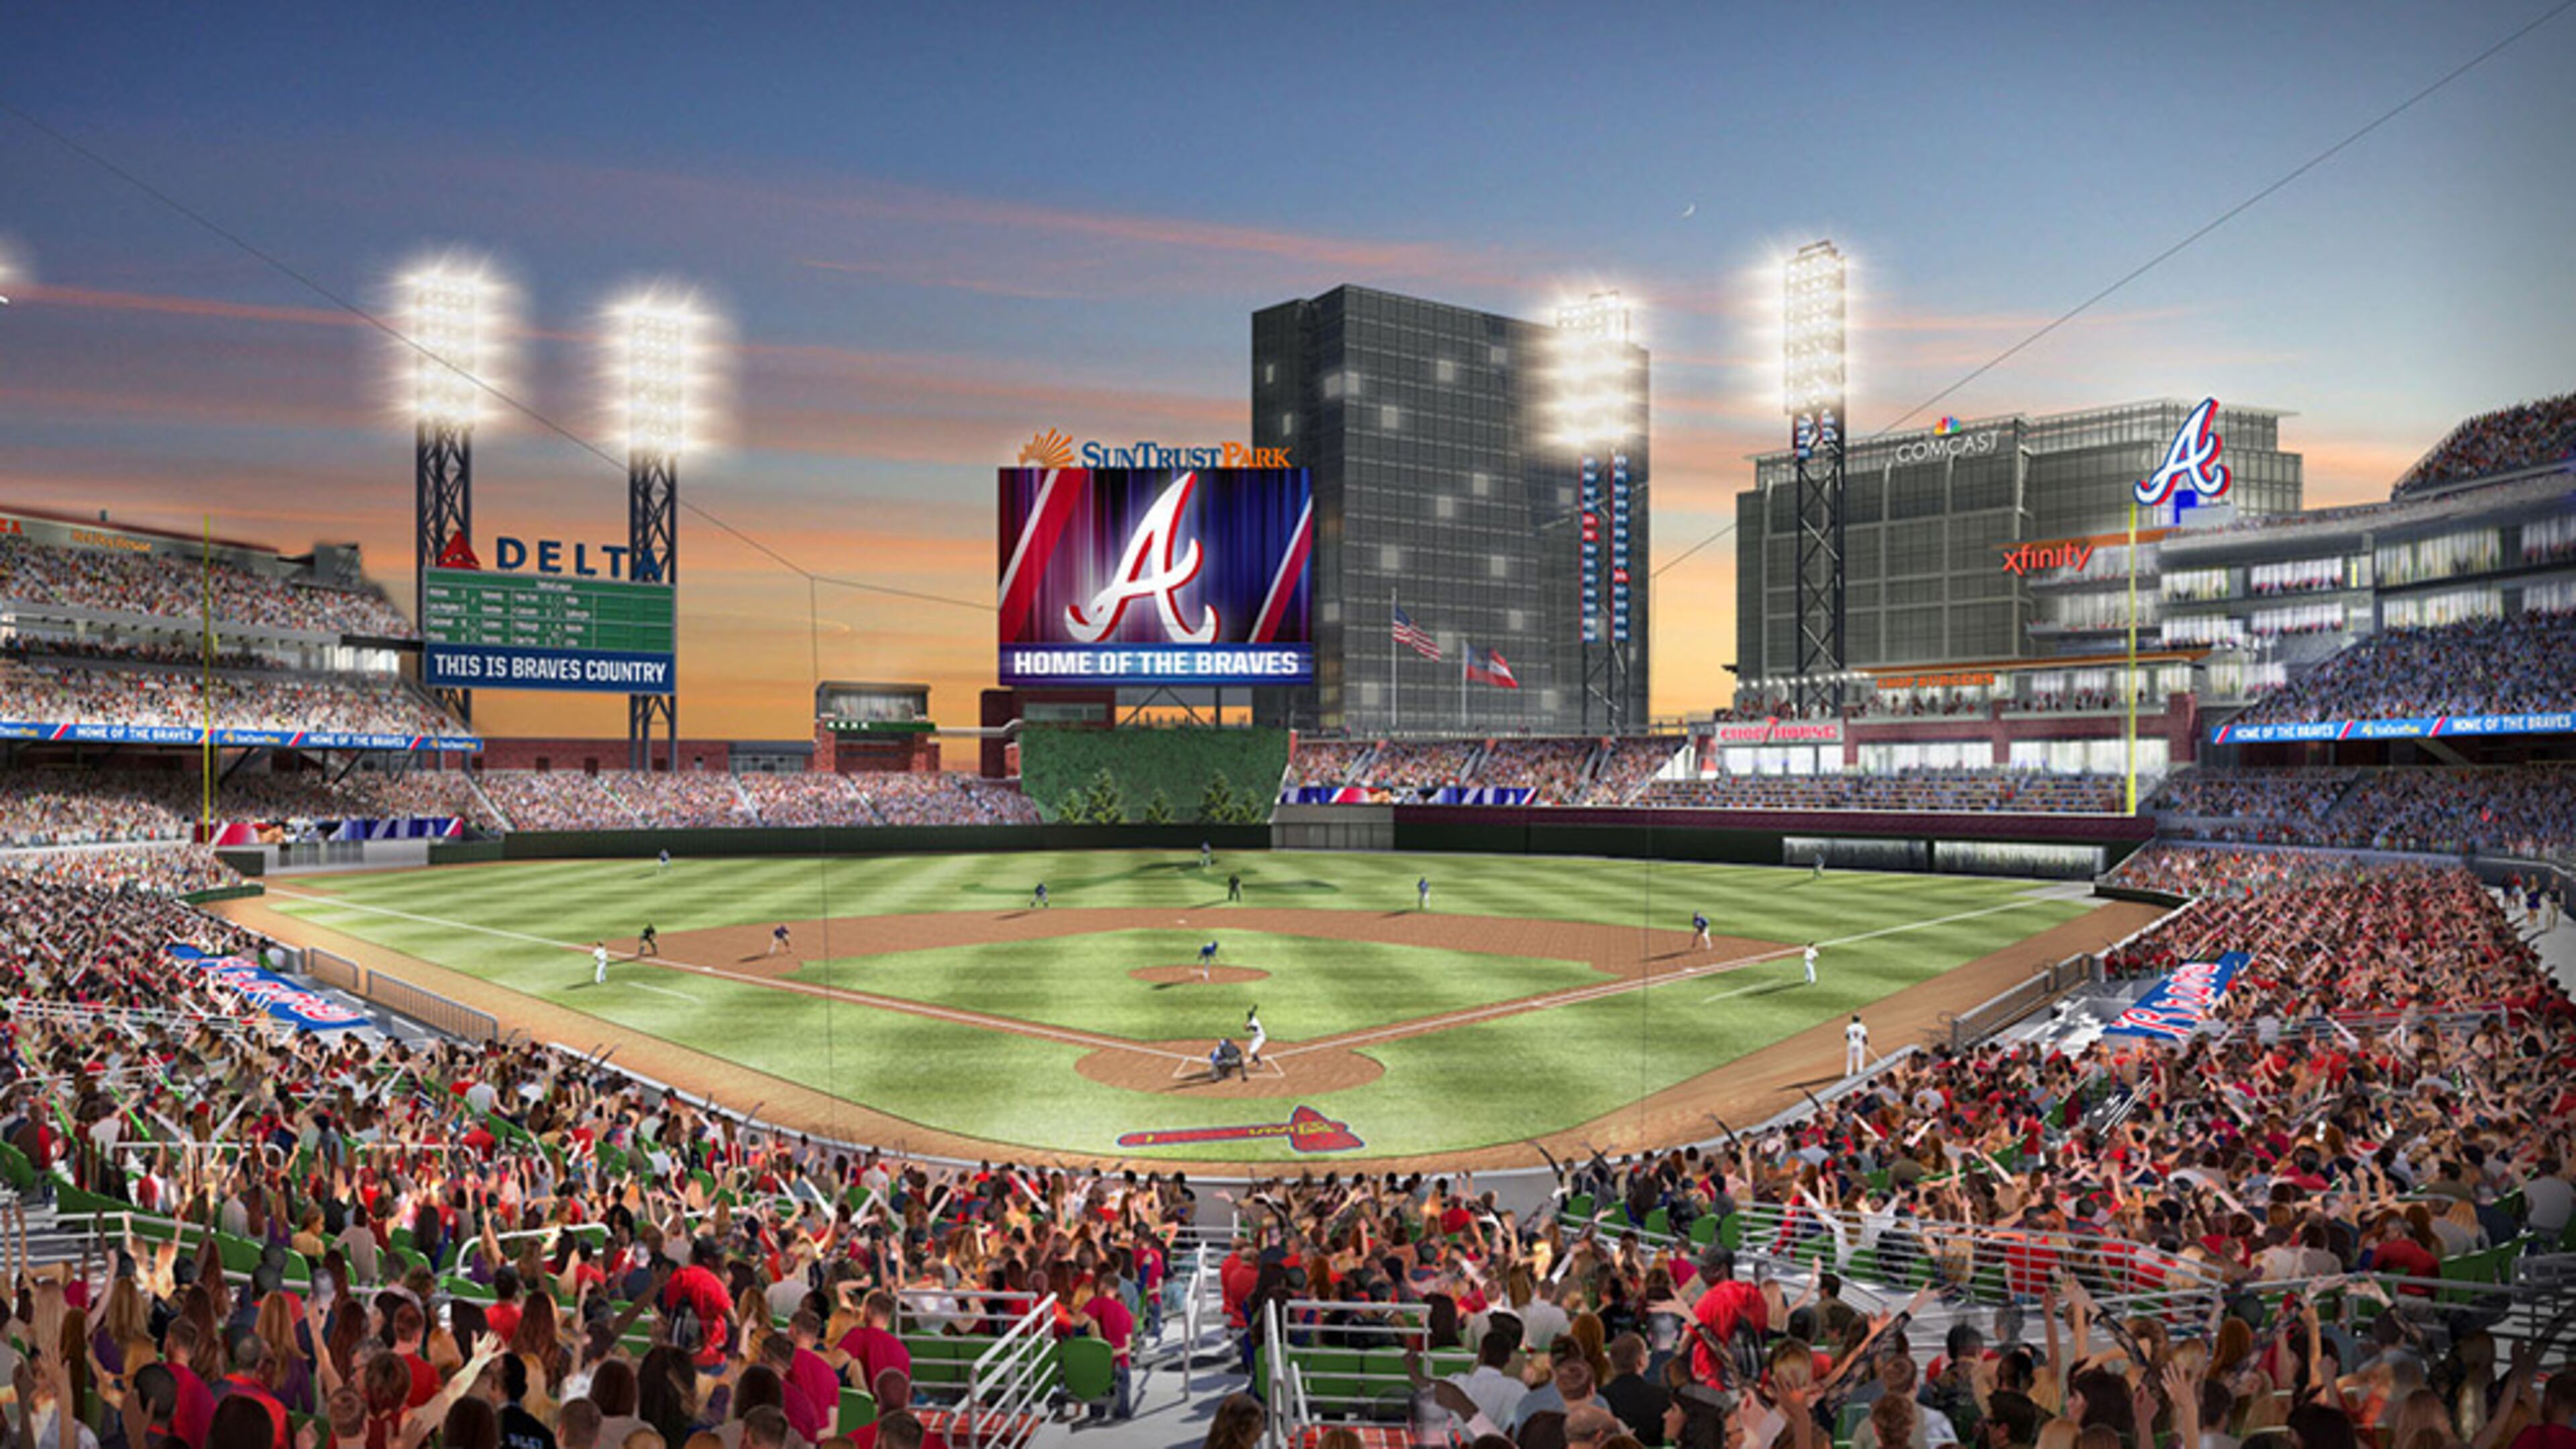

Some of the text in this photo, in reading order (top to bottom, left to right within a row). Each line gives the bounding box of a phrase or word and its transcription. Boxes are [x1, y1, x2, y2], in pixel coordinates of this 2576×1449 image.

[1896, 431, 1999, 462] COMCAST
[496, 537, 662, 581] DELTA
[2002, 541, 2094, 576] xfinity
[434, 653, 666, 683] THIS IS BRAVES COUNTRY
[1014, 651, 1299, 675] HOME OF THE BRAVES
